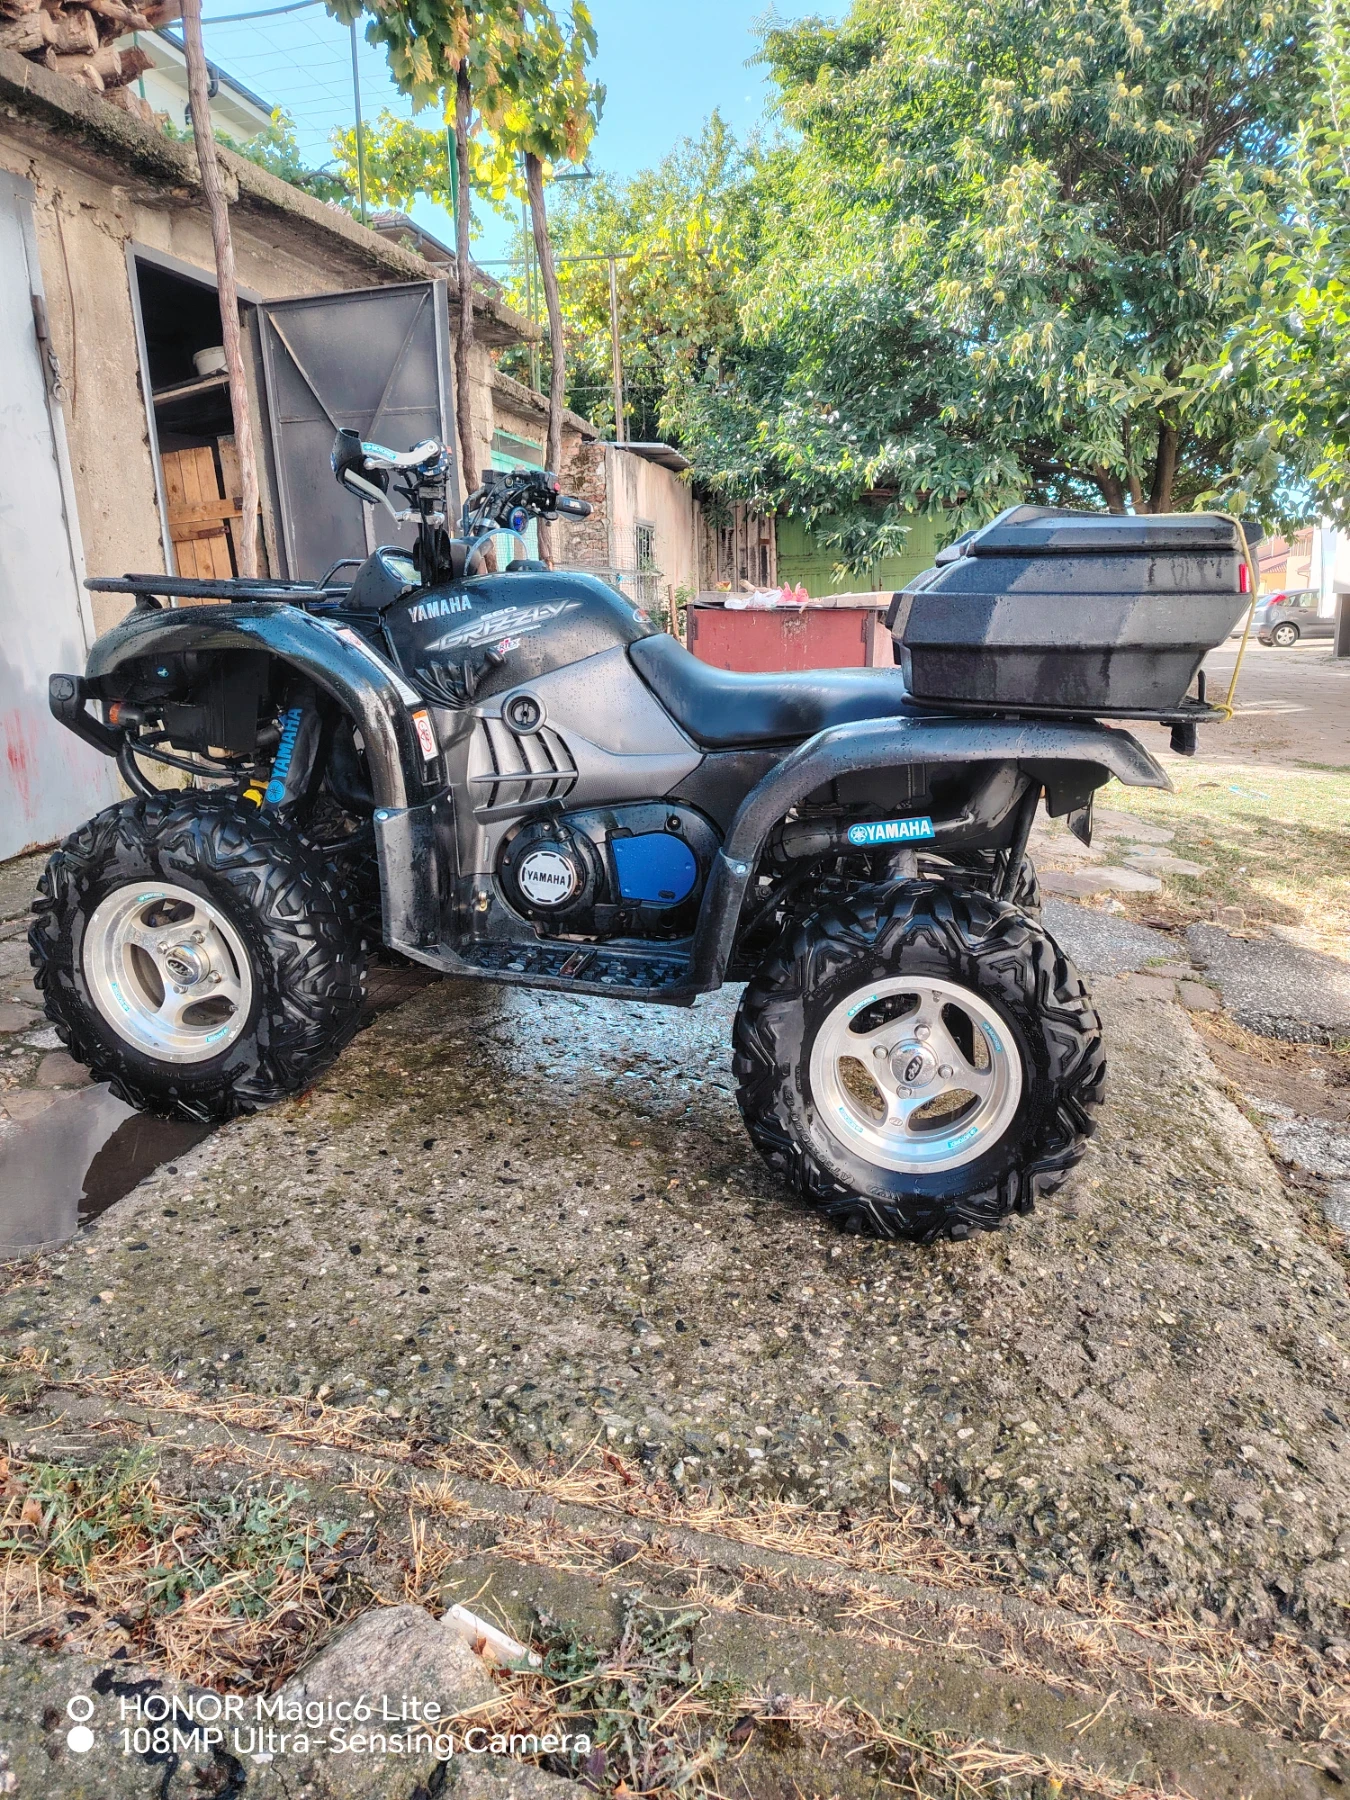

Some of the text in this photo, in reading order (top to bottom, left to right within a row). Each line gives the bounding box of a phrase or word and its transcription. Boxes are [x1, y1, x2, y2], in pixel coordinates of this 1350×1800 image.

[407, 594, 473, 623] YAMAHA
[439, 600, 570, 651] GRIZZLY
[271, 708, 303, 778] YAMAHA
[866, 820, 931, 841] YAMAHA
[528, 870, 566, 886] YAMAHA
